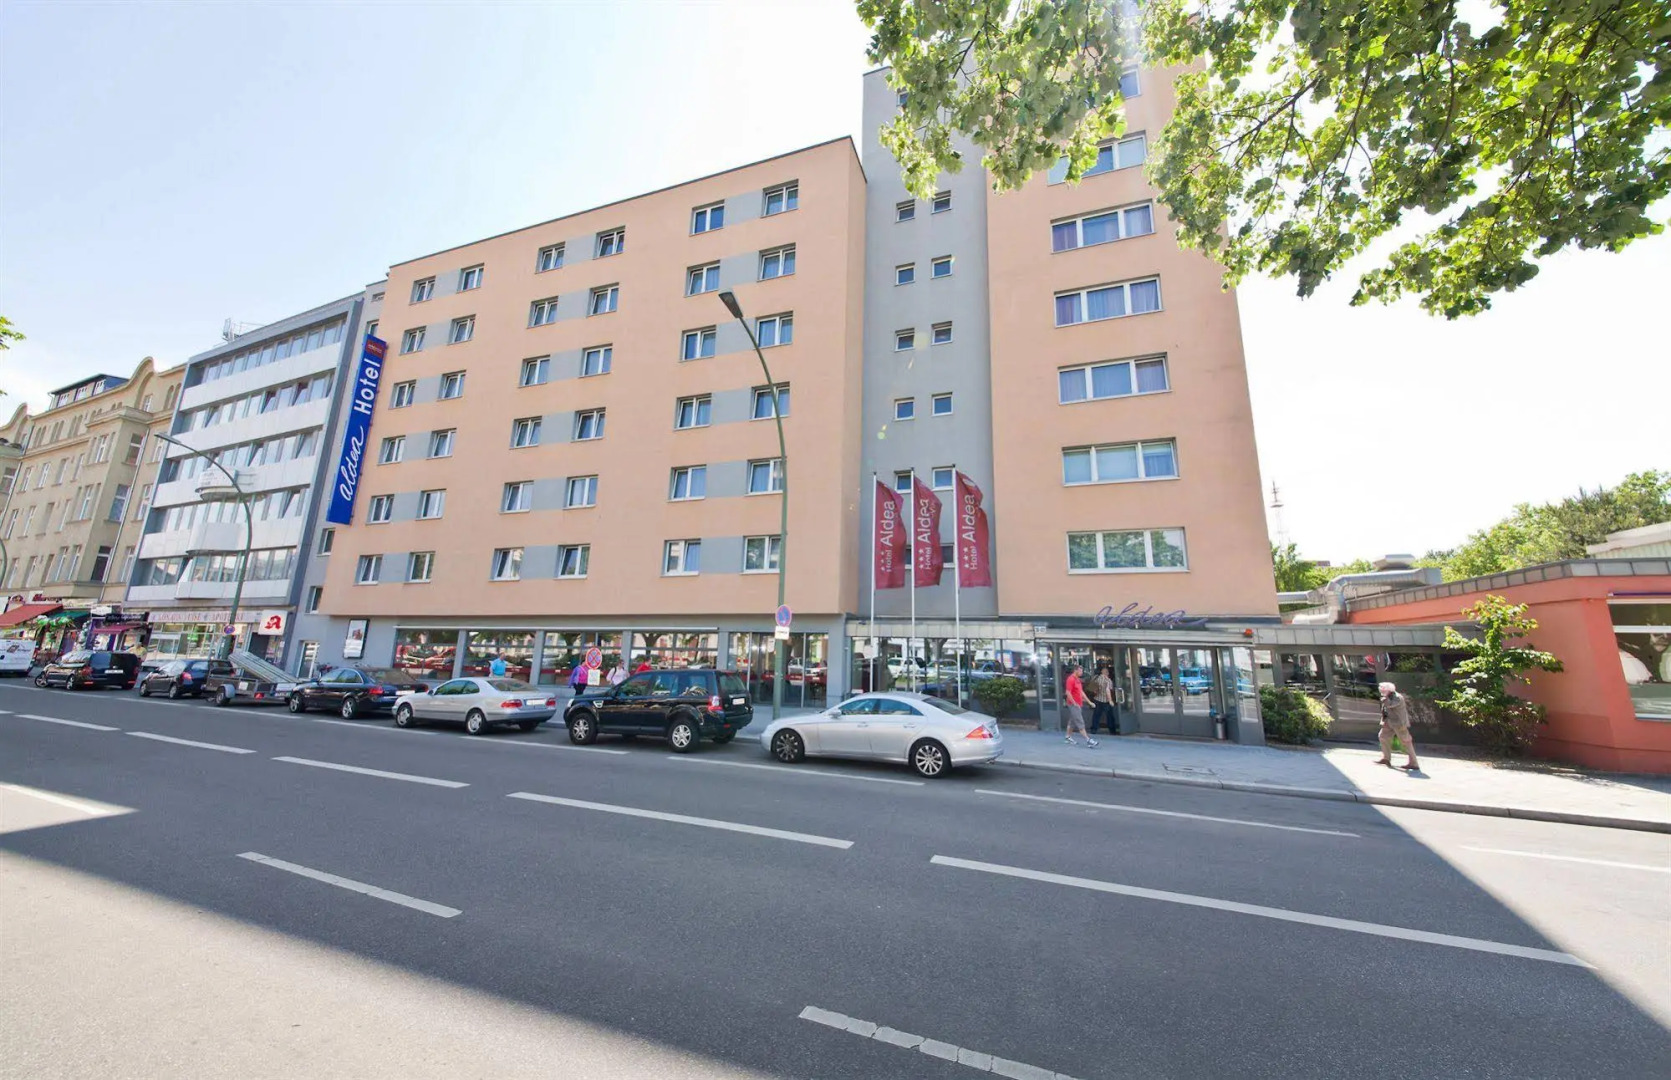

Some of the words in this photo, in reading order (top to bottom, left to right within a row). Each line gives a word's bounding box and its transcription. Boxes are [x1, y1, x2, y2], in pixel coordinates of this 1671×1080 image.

[353, 358, 381, 415] Hotel
[880, 500, 895, 546] Aldea
[917, 499, 931, 544] Aldea
[962, 494, 976, 543] Aldea
[885, 549, 893, 572] Hotel
[924, 547, 932, 570] Hotel
[970, 546, 978, 570] Hotel
